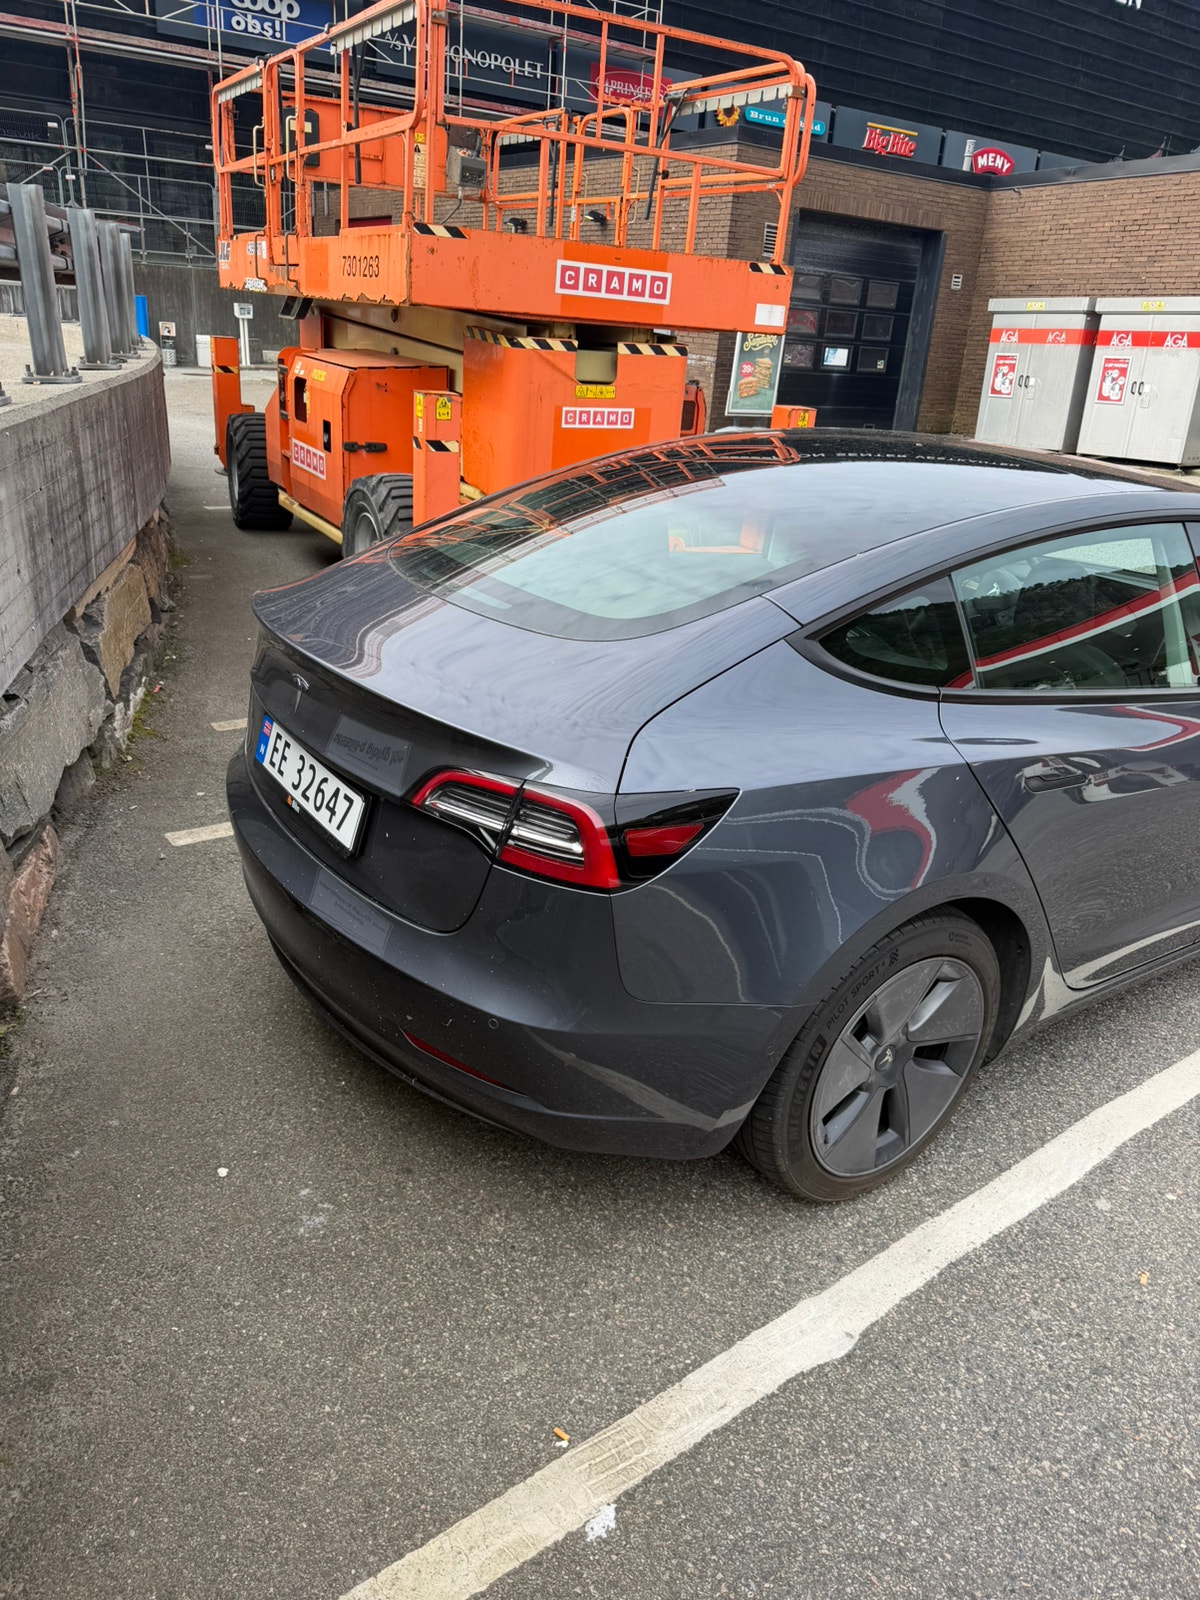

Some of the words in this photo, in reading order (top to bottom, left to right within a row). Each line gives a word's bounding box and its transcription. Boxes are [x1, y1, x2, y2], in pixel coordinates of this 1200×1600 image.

[230, 13, 282, 38] obs!
[749, 110, 779, 123] Brun
[862, 128, 889, 156] Big
[886, 132, 917, 158] Bite
[977, 152, 1011, 173] MENY
[342, 255, 380, 278] 7301263
[563, 270, 664, 296] CRAMO
[1000, 329, 1019, 344] AGA
[1046, 329, 1067, 344] AGA
[1110, 332, 1133, 347] AGA
[1164, 332, 1188, 348] AGA
[566, 412, 630, 423] CRAMO
[294, 444, 325, 471] CRAMO
[268, 732, 291, 778] EE
[291, 754, 355, 831] 32647
[826, 998, 850, 1030] PILOT
[851, 965, 880, 998] SPORT
